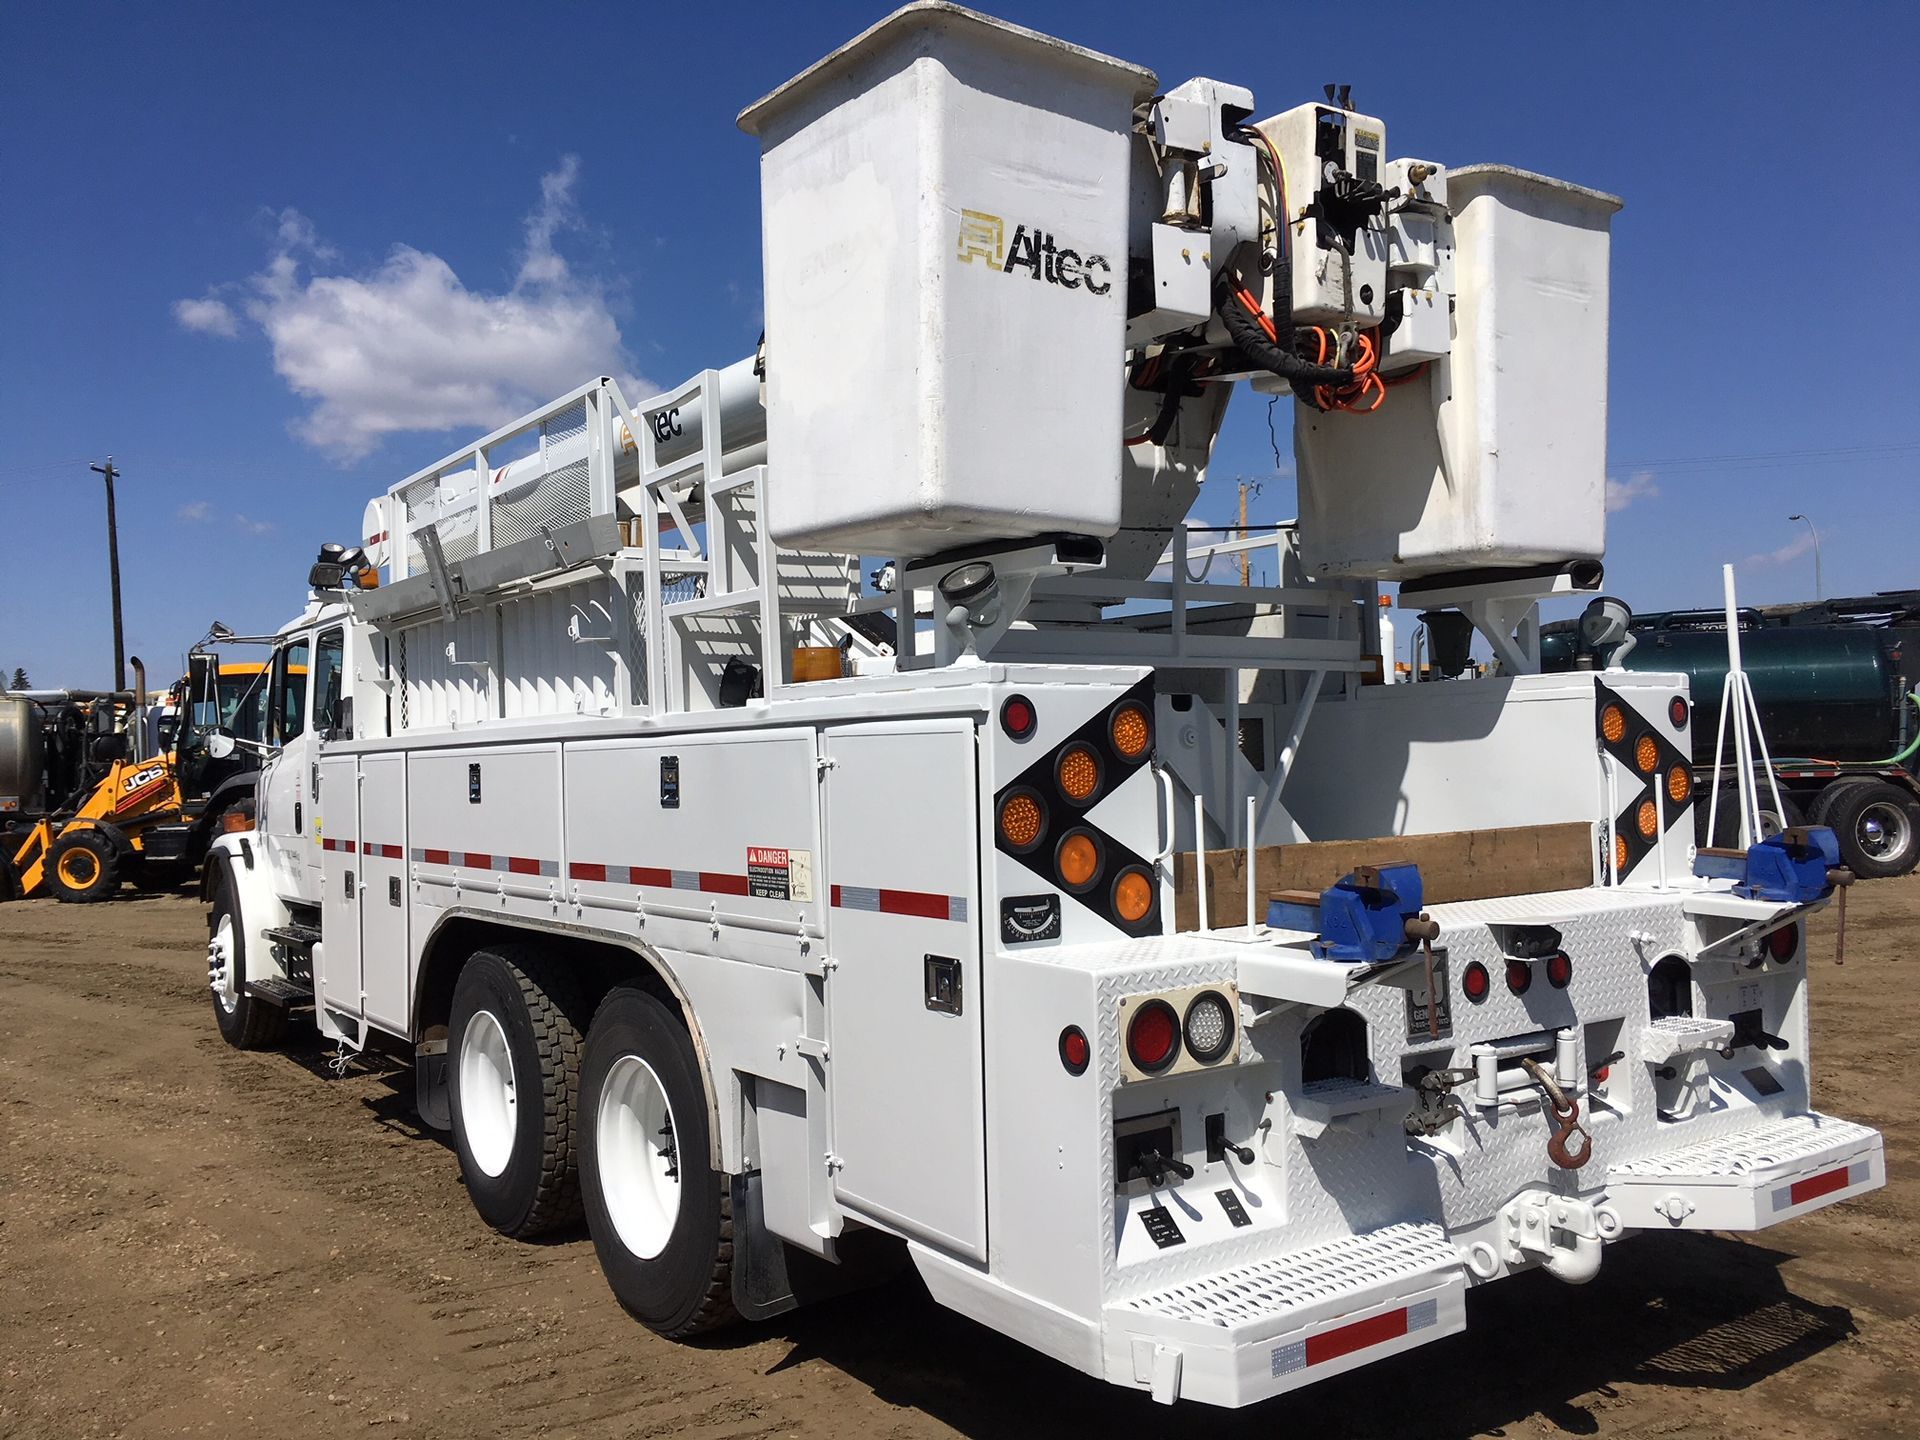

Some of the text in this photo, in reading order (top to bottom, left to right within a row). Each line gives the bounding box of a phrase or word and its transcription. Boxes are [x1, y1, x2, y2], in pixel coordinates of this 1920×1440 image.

[1004, 224, 1112, 296] Altec
[125, 764, 164, 791] JCB
[757, 850, 787, 865] DANGER
[755, 888, 785, 899] KEEP CLEAR
